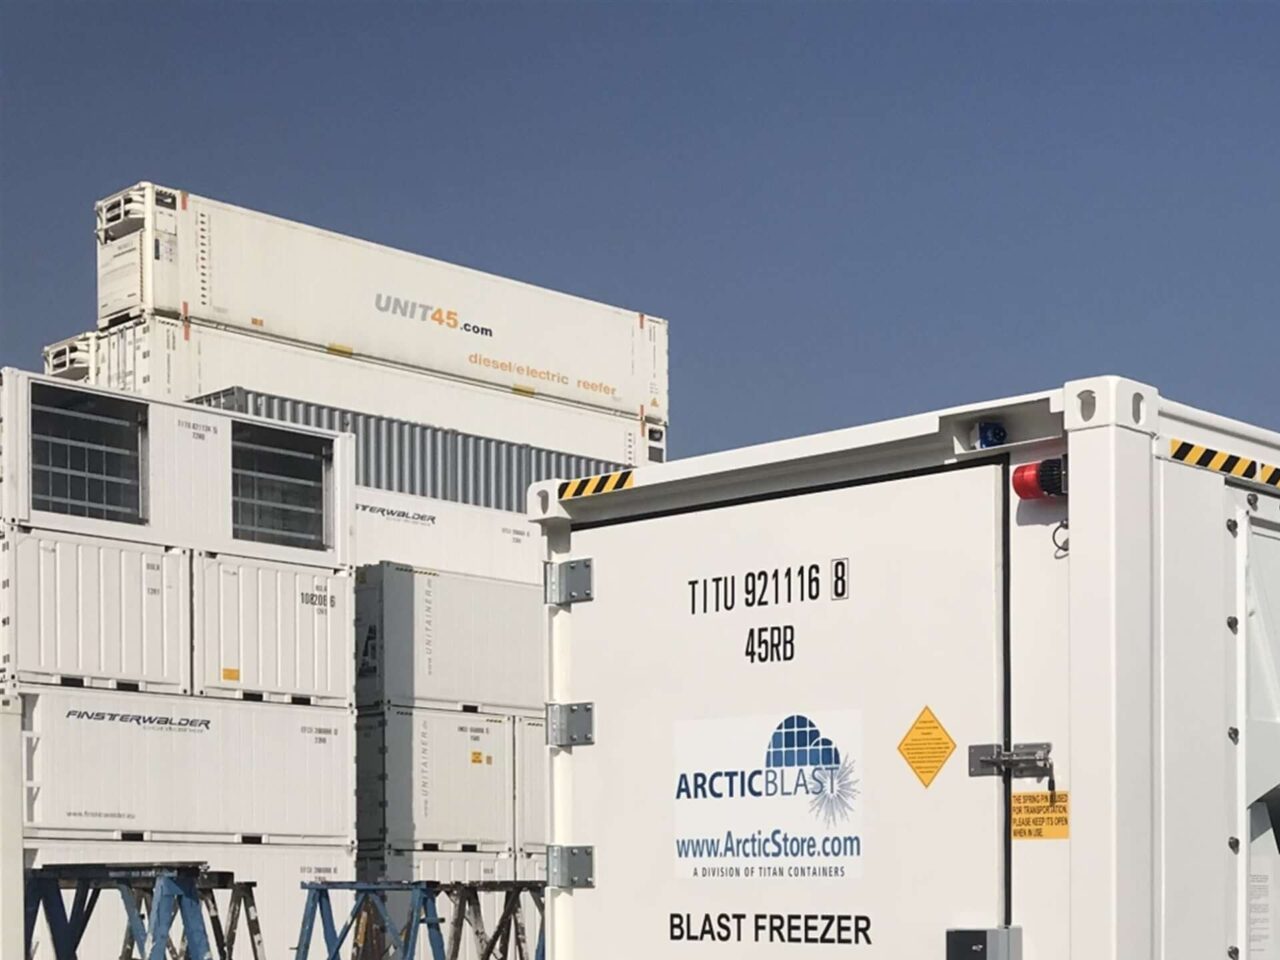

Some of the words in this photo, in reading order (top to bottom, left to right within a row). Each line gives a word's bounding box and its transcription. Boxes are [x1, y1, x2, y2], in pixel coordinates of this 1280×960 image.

[576, 378, 617, 396] reefer
[688, 575, 735, 615] TITU
[745, 564, 820, 607] 921116
[834, 560, 846, 597] 8
[745, 625, 794, 663] 45RB
[676, 767, 839, 800] ARCTICBLAST
[676, 829, 861, 859] www.ArcticStore.com
[693, 867, 698, 877] A
[702, 866, 740, 877] DIVISION
[744, 866, 754, 877] OF
[758, 866, 784, 877] TITAN
[788, 866, 845, 877] CONTAINERS
[670, 913, 746, 942] BLAST
[755, 914, 872, 945] FREEZER
